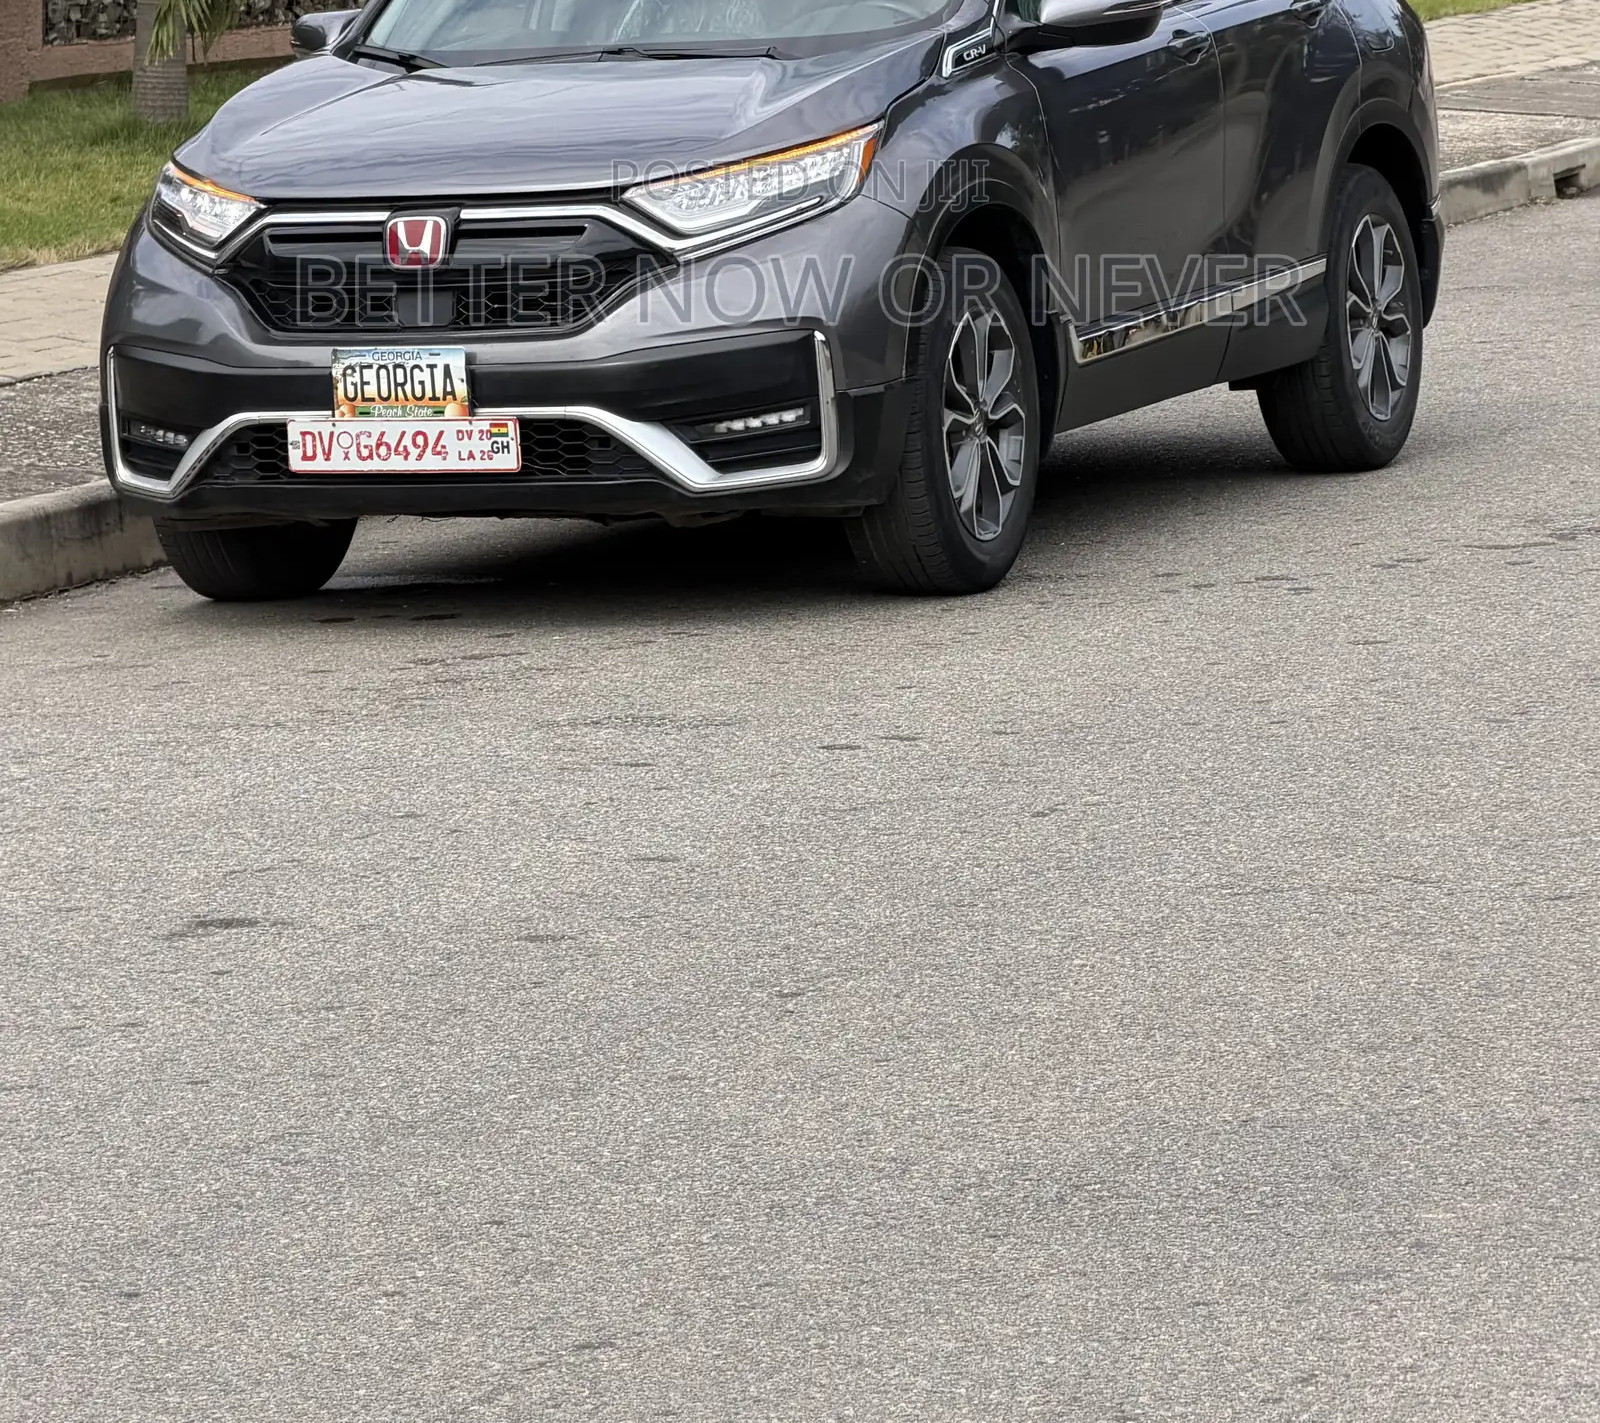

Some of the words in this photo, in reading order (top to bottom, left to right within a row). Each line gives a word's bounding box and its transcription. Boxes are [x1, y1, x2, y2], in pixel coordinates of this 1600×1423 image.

[963, 44, 986, 61] CR-V
[371, 351, 423, 361] GEORGIA
[342, 363, 458, 402] GEORGIA
[370, 404, 403, 418] Peach
[405, 404, 434, 417] State
[456, 429, 473, 441] DV
[478, 429, 492, 440] 20
[300, 431, 334, 461] DV
[491, 440, 510, 454] GH
[458, 450, 476, 461] LA
